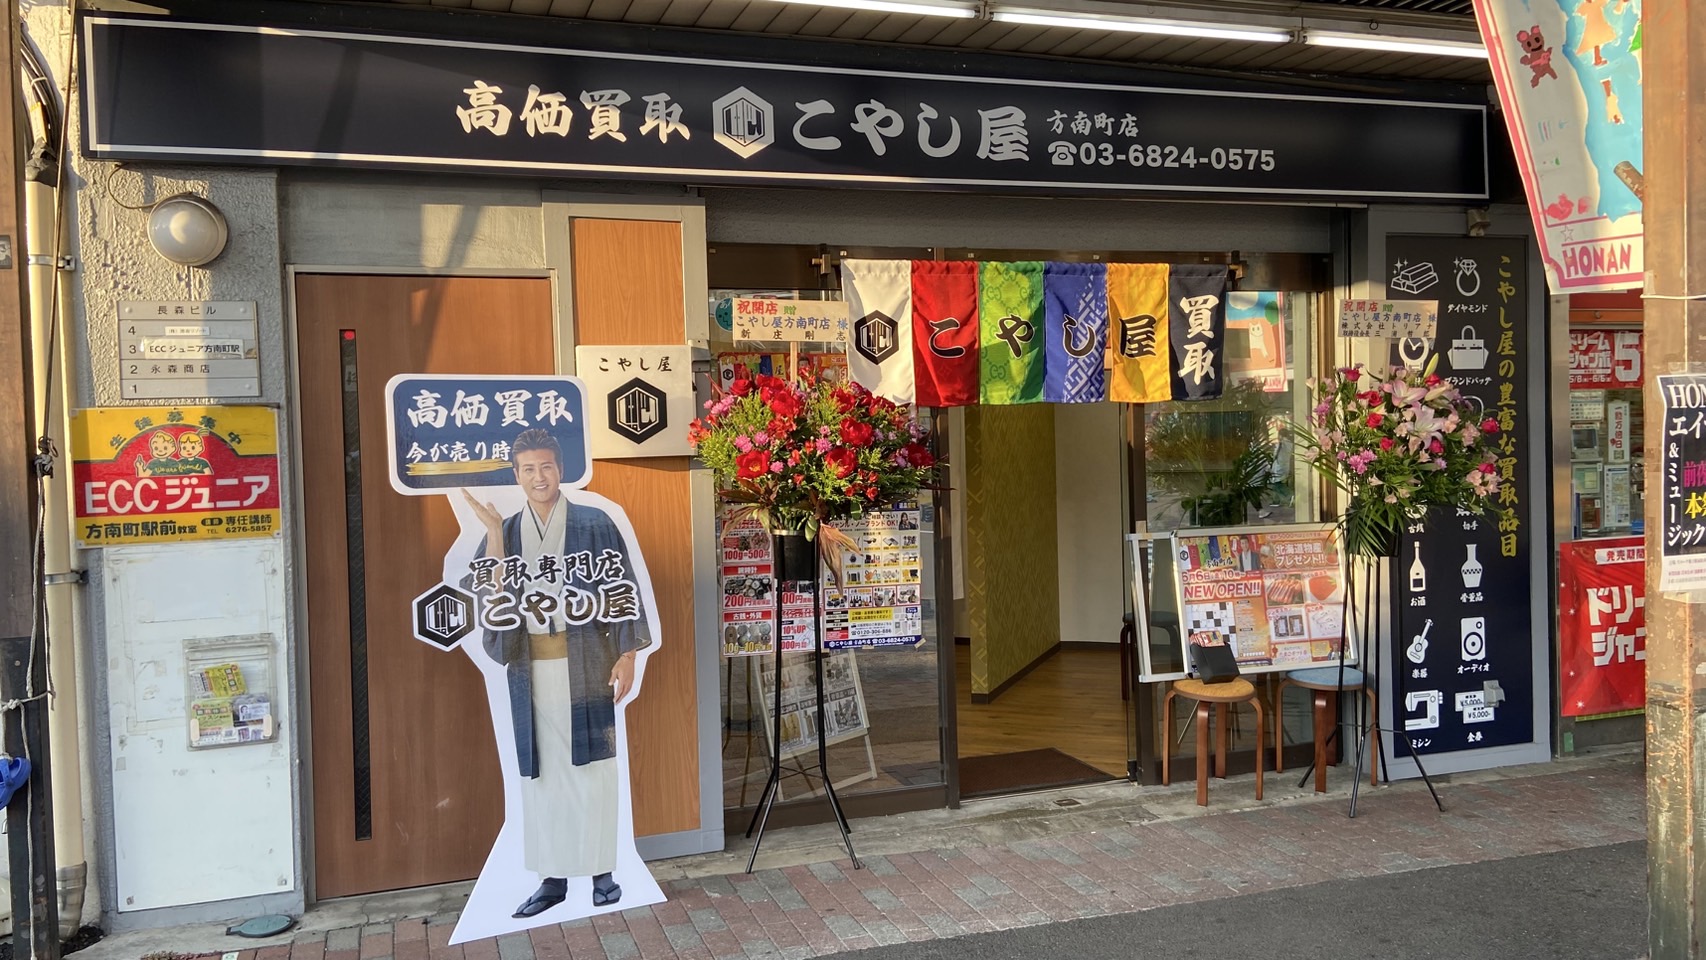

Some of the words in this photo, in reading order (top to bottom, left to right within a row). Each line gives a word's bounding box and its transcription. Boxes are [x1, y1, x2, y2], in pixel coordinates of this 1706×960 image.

[456, 80, 691, 144] 高価買取
[793, 98, 1031, 162] こやし屋
[1046, 109, 1139, 138] 方南町店
[1078, 141, 1276, 172] 03-6824-0575
[1561, 243, 1633, 279] HONAN
[157, 305, 217, 315] 長森ビル
[737, 300, 778, 315] 祝開店
[1343, 300, 1379, 312] 祝開店
[1447, 303, 1489, 314] ダイヤモンド
[736, 315, 831, 329] こやし屋方南町店
[127, 326, 136, 335] 4
[1178, 294, 1219, 386] 買取
[128, 345, 137, 354] 3
[130, 364, 138, 375] 2
[150, 364, 210, 374] 永森商店
[598, 355, 673, 373] こやし屋
[132, 385, 138, 394] 1
[406, 389, 573, 428] 高価買取
[1668, 411, 1706, 440] エイ
[406, 440, 512, 463] 今が売り時
[1684, 492, 1706, 520] 本
[1462, 521, 1480, 532] 切手
[469, 550, 624, 590] 買取専門店
[1184, 584, 1216, 599] NEW
[1217, 581, 1261, 597] OPEN!!
[481, 582, 640, 630] こやし屋
[1410, 597, 1427, 607] お酒
[1411, 668, 1429, 679] 楽器
[1457, 662, 1491, 674] オーディオ
[1411, 738, 1432, 749] ミシン
